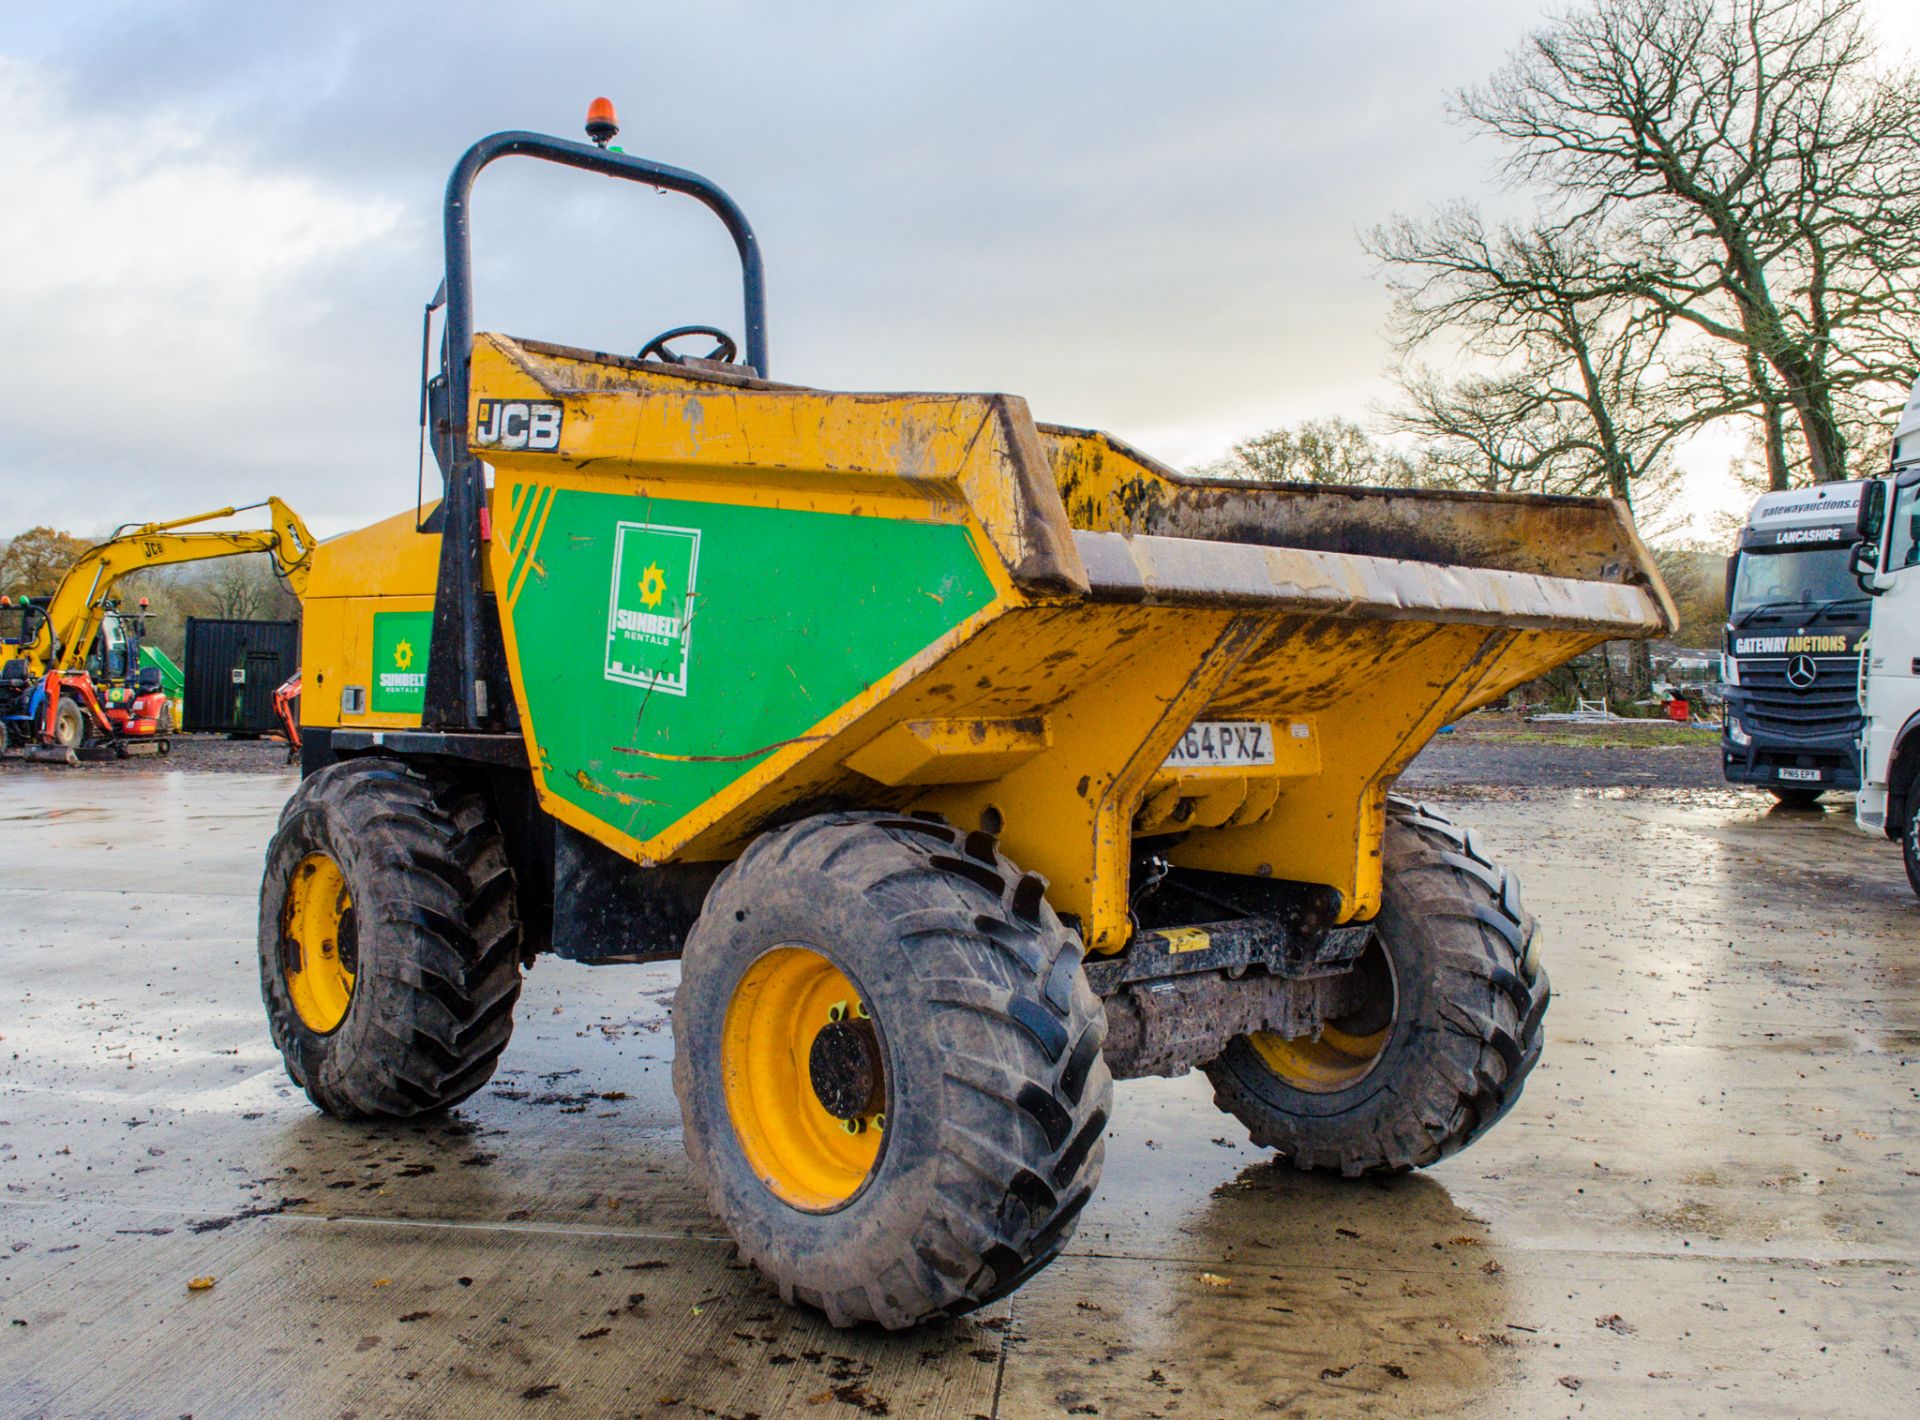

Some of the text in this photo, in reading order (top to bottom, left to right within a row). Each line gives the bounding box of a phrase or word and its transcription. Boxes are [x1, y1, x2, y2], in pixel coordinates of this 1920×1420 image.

[477, 403, 562, 449] JCB
[1776, 528, 1842, 544] LANCASHIRE
[144, 541, 164, 558] JCB
[617, 608, 682, 639] SUNBELT
[624, 630, 670, 647] RENTALS
[380, 673, 426, 687] SUNBELT
[1219, 726, 1265, 761] PXZ
